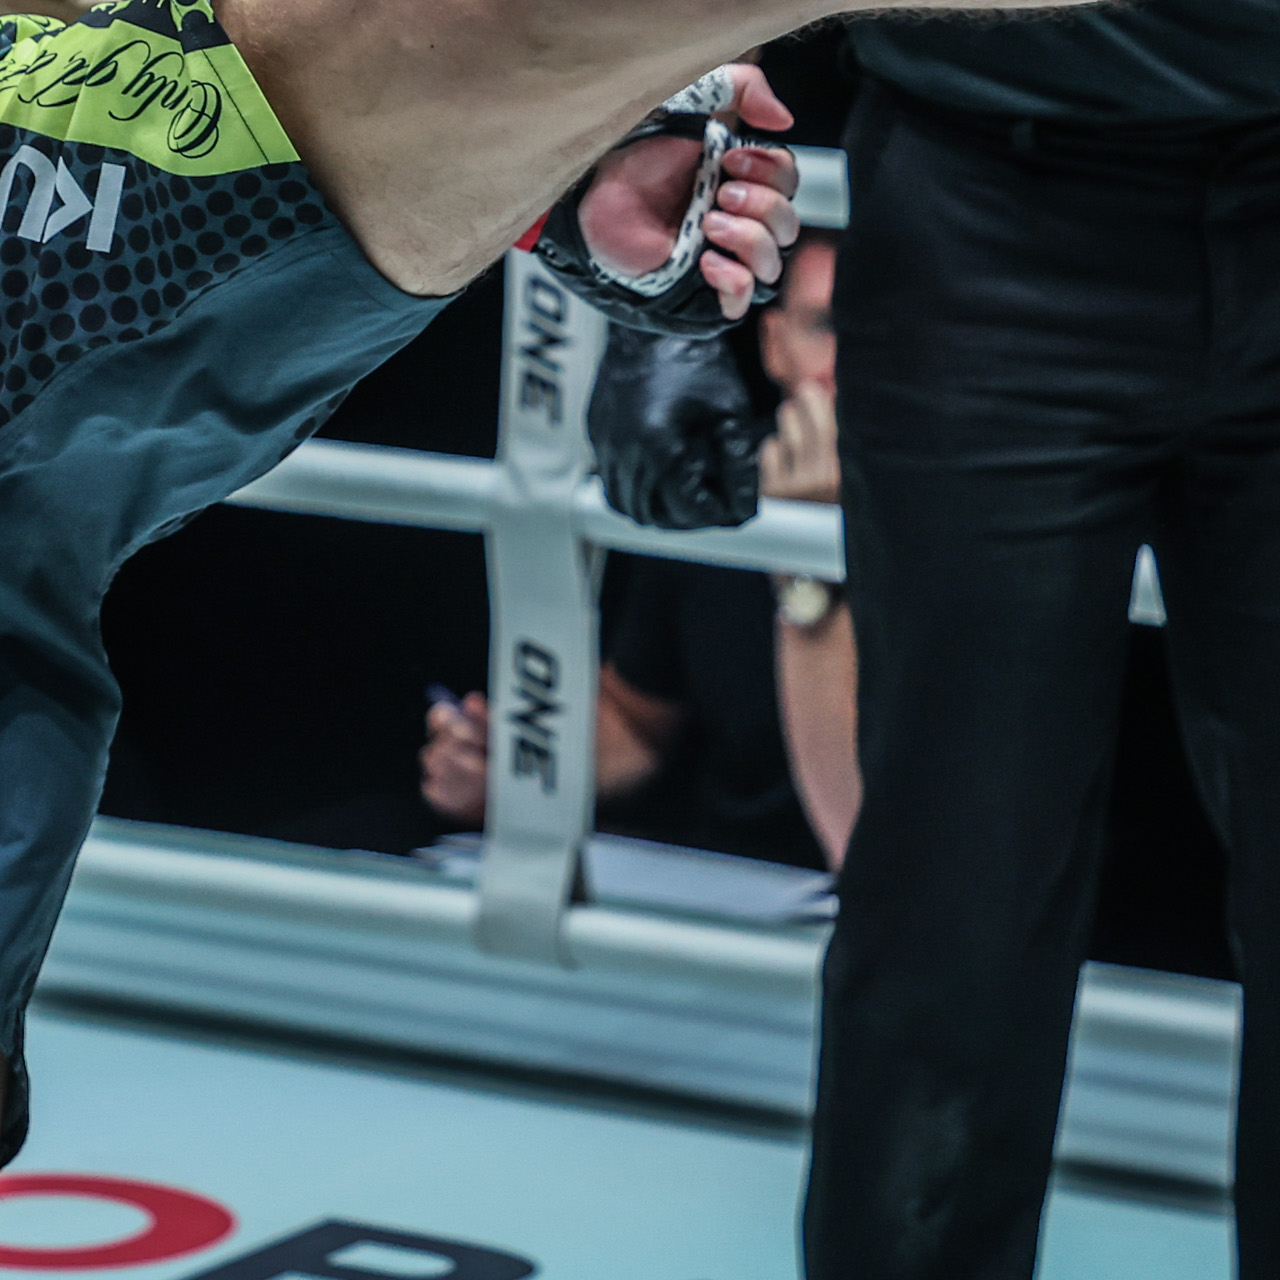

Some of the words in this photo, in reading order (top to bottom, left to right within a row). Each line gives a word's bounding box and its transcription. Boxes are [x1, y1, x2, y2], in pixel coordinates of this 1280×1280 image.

[108, 50, 222, 159] Only
[518, 275, 573, 428] ONE
[508, 639, 567, 797] ONE
